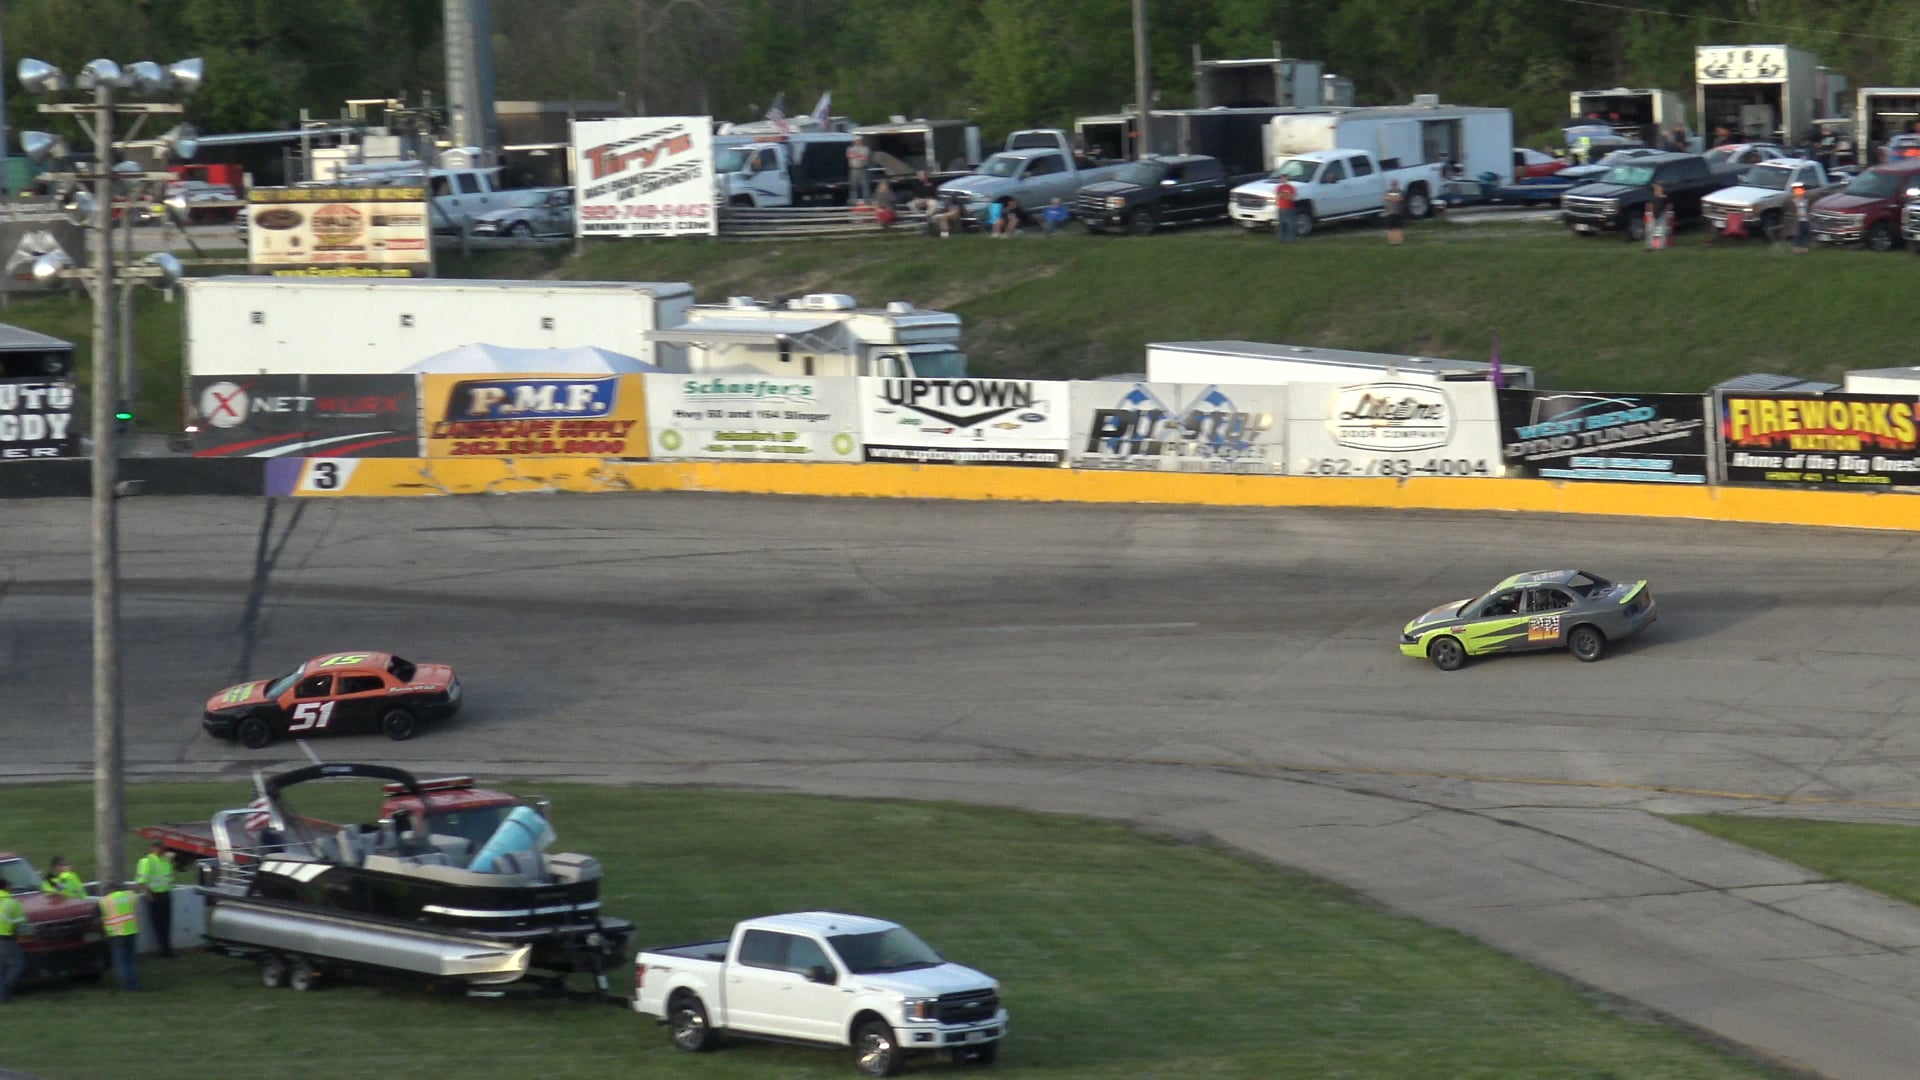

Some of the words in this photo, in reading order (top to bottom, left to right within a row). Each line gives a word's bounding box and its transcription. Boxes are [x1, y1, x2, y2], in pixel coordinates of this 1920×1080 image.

[584, 132, 694, 180] Tiry's
[466, 384, 606, 416] P.M.F.
[683, 378, 814, 397] Schaefer's
[886, 379, 1033, 408] UPTOWN
[1728, 399, 1917, 443] FIREWORKS
[1733, 452, 1783, 468] Home
[314, 462, 339, 490] 3
[289, 701, 336, 731] 51
